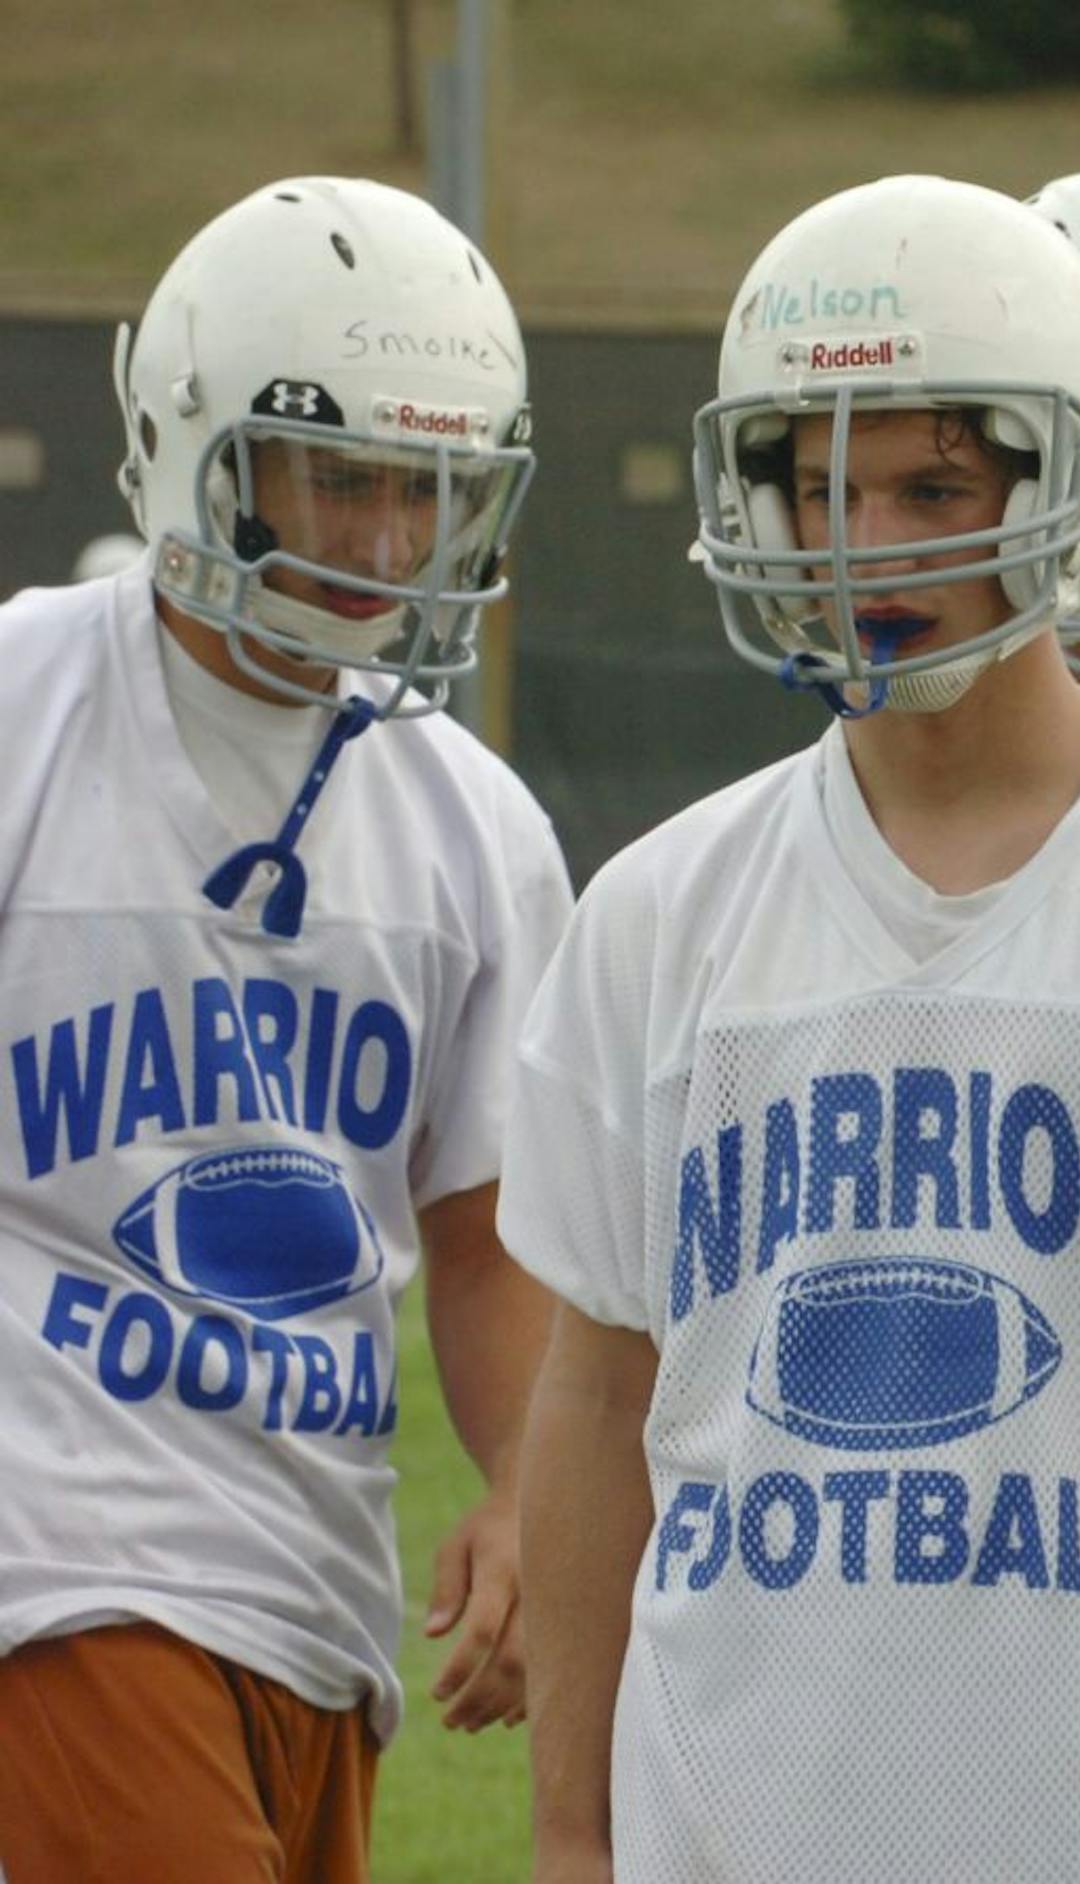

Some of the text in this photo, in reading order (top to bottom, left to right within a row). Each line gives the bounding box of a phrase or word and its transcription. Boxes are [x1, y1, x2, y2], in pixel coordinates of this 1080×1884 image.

[761, 279, 909, 330] Nelson
[811, 341, 893, 369] Riddell
[399, 404, 467, 435] Riddell
[42, 1271, 397, 1437] FOOTBA
